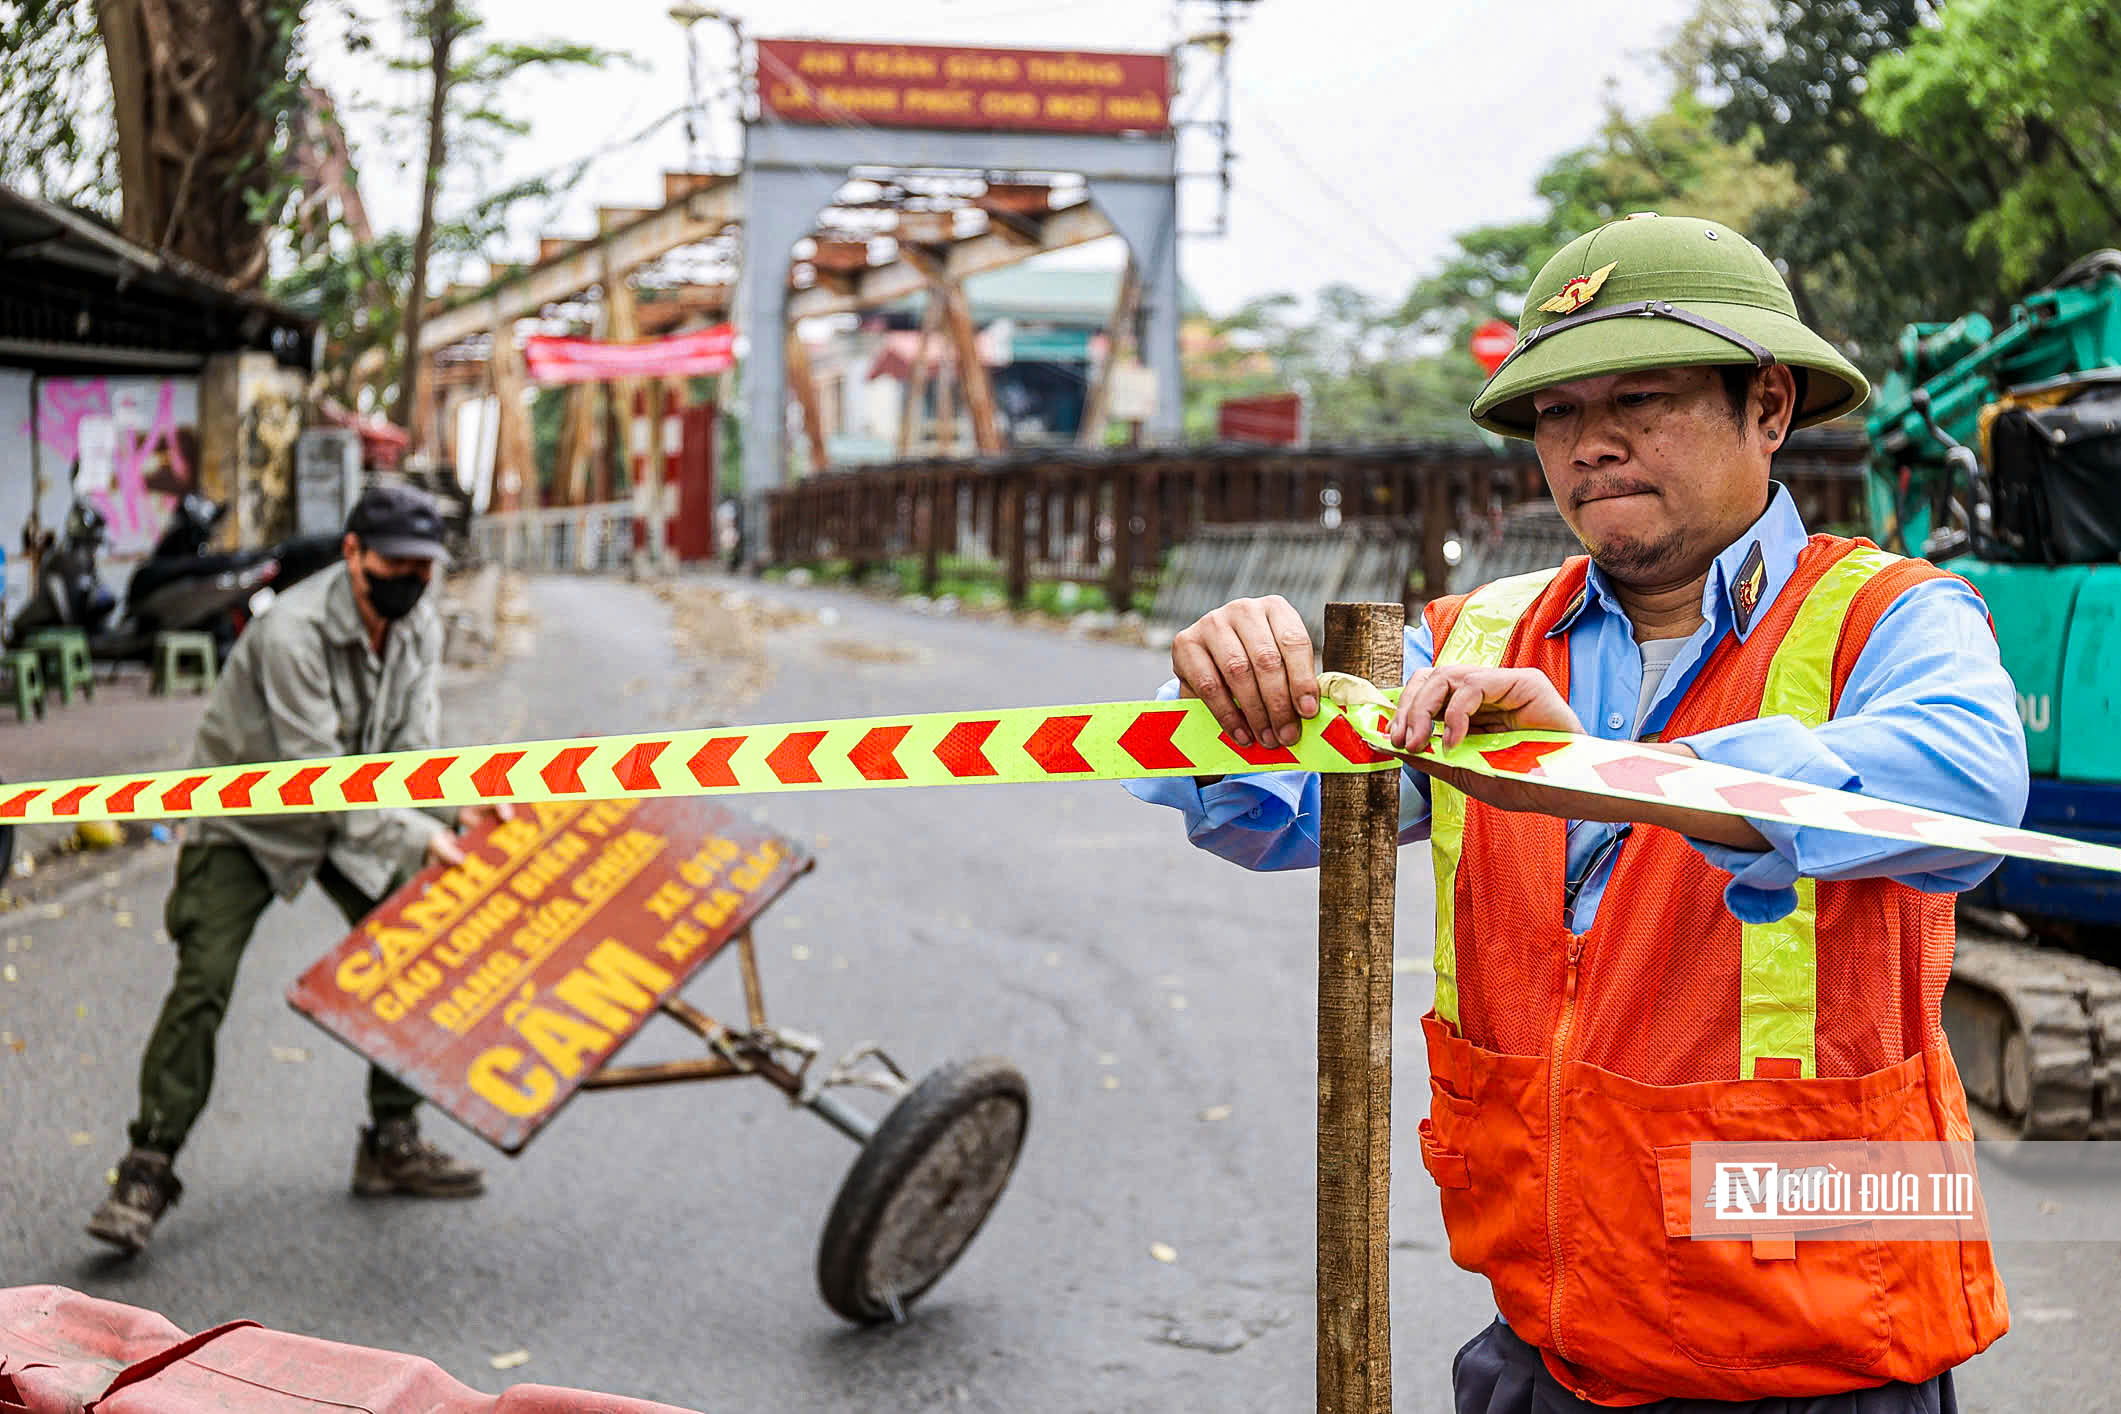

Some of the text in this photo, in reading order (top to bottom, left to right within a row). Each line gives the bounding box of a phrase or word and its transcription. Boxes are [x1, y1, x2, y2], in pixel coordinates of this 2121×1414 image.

[645, 880, 695, 920] XE
[657, 919, 708, 961] XE
[467, 938, 675, 1117] CẤM
